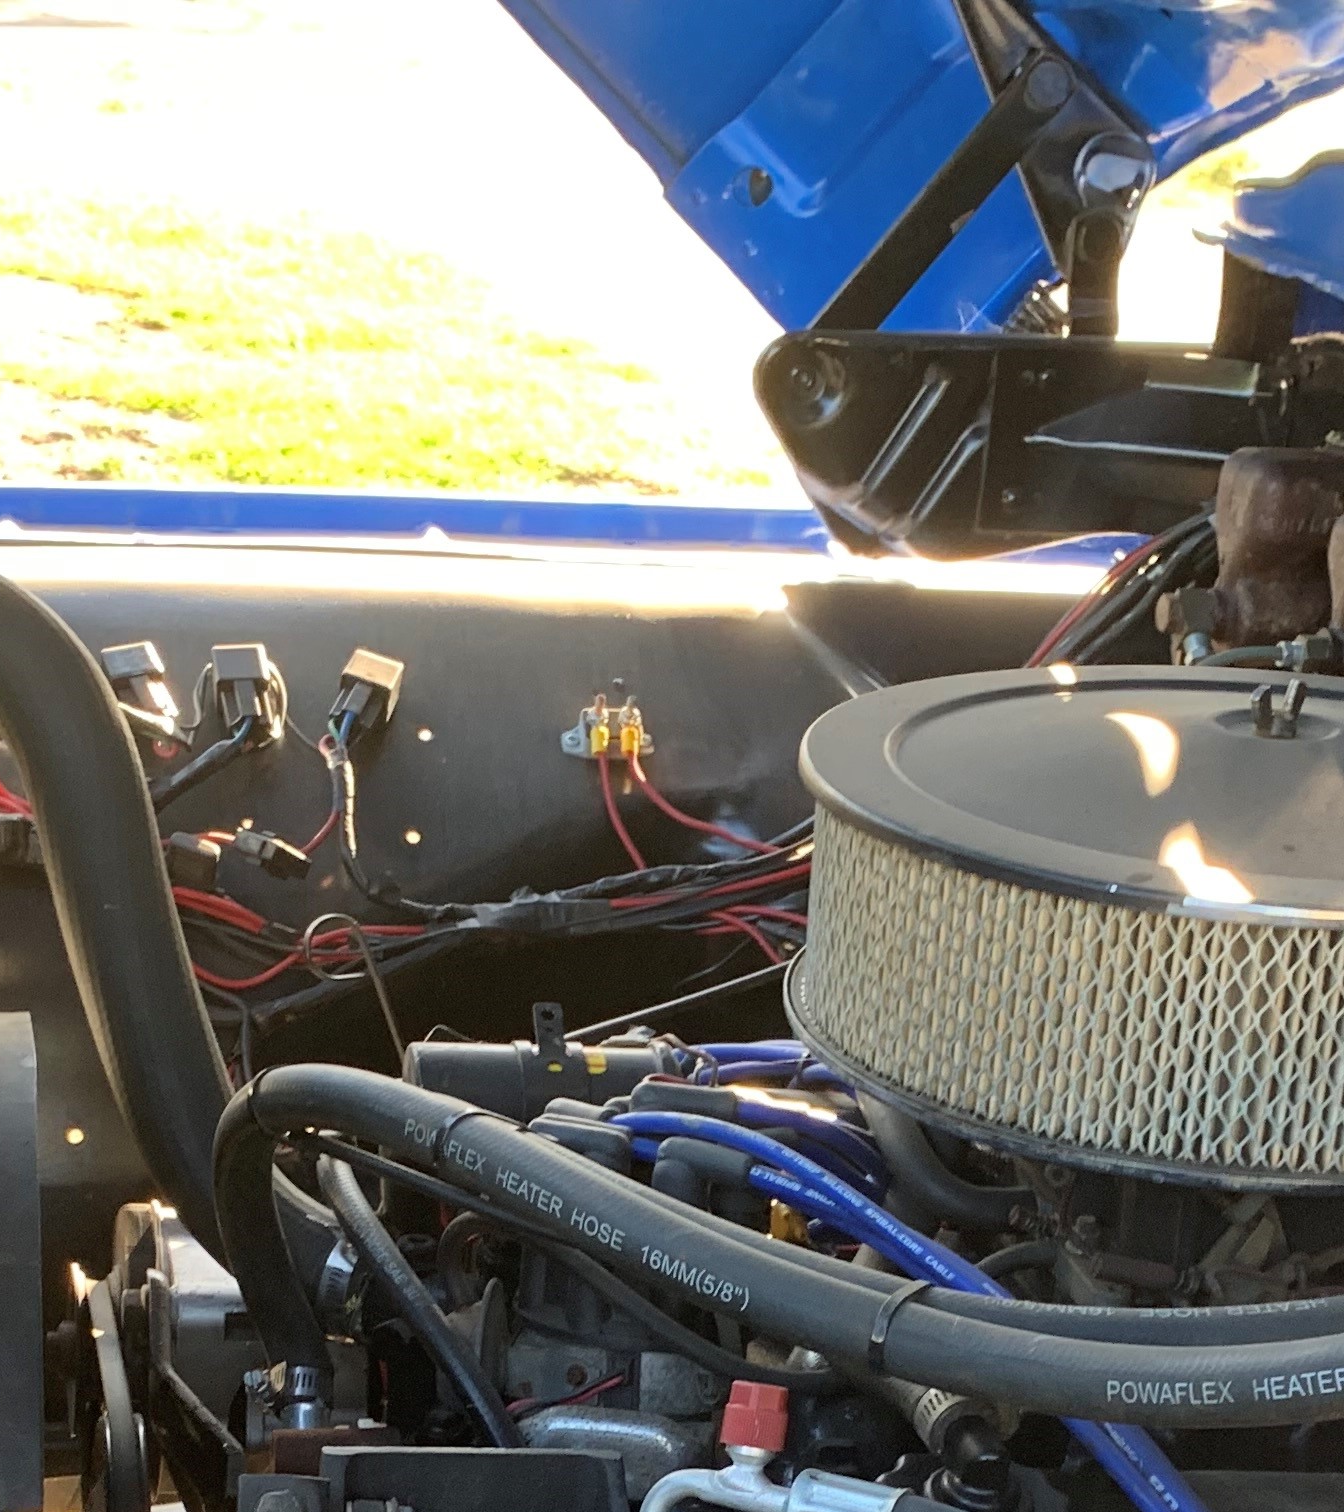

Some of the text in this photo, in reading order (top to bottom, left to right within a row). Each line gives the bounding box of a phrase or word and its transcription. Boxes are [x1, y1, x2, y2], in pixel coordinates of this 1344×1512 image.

[495, 1166, 564, 1219] HEATER
[570, 1205, 626, 1252] HOSE
[638, 1244, 751, 1312] 16MM(5/8")
[924, 1254, 957, 1282] CABLE
[1105, 1378, 1235, 1406] POWAFLEX
